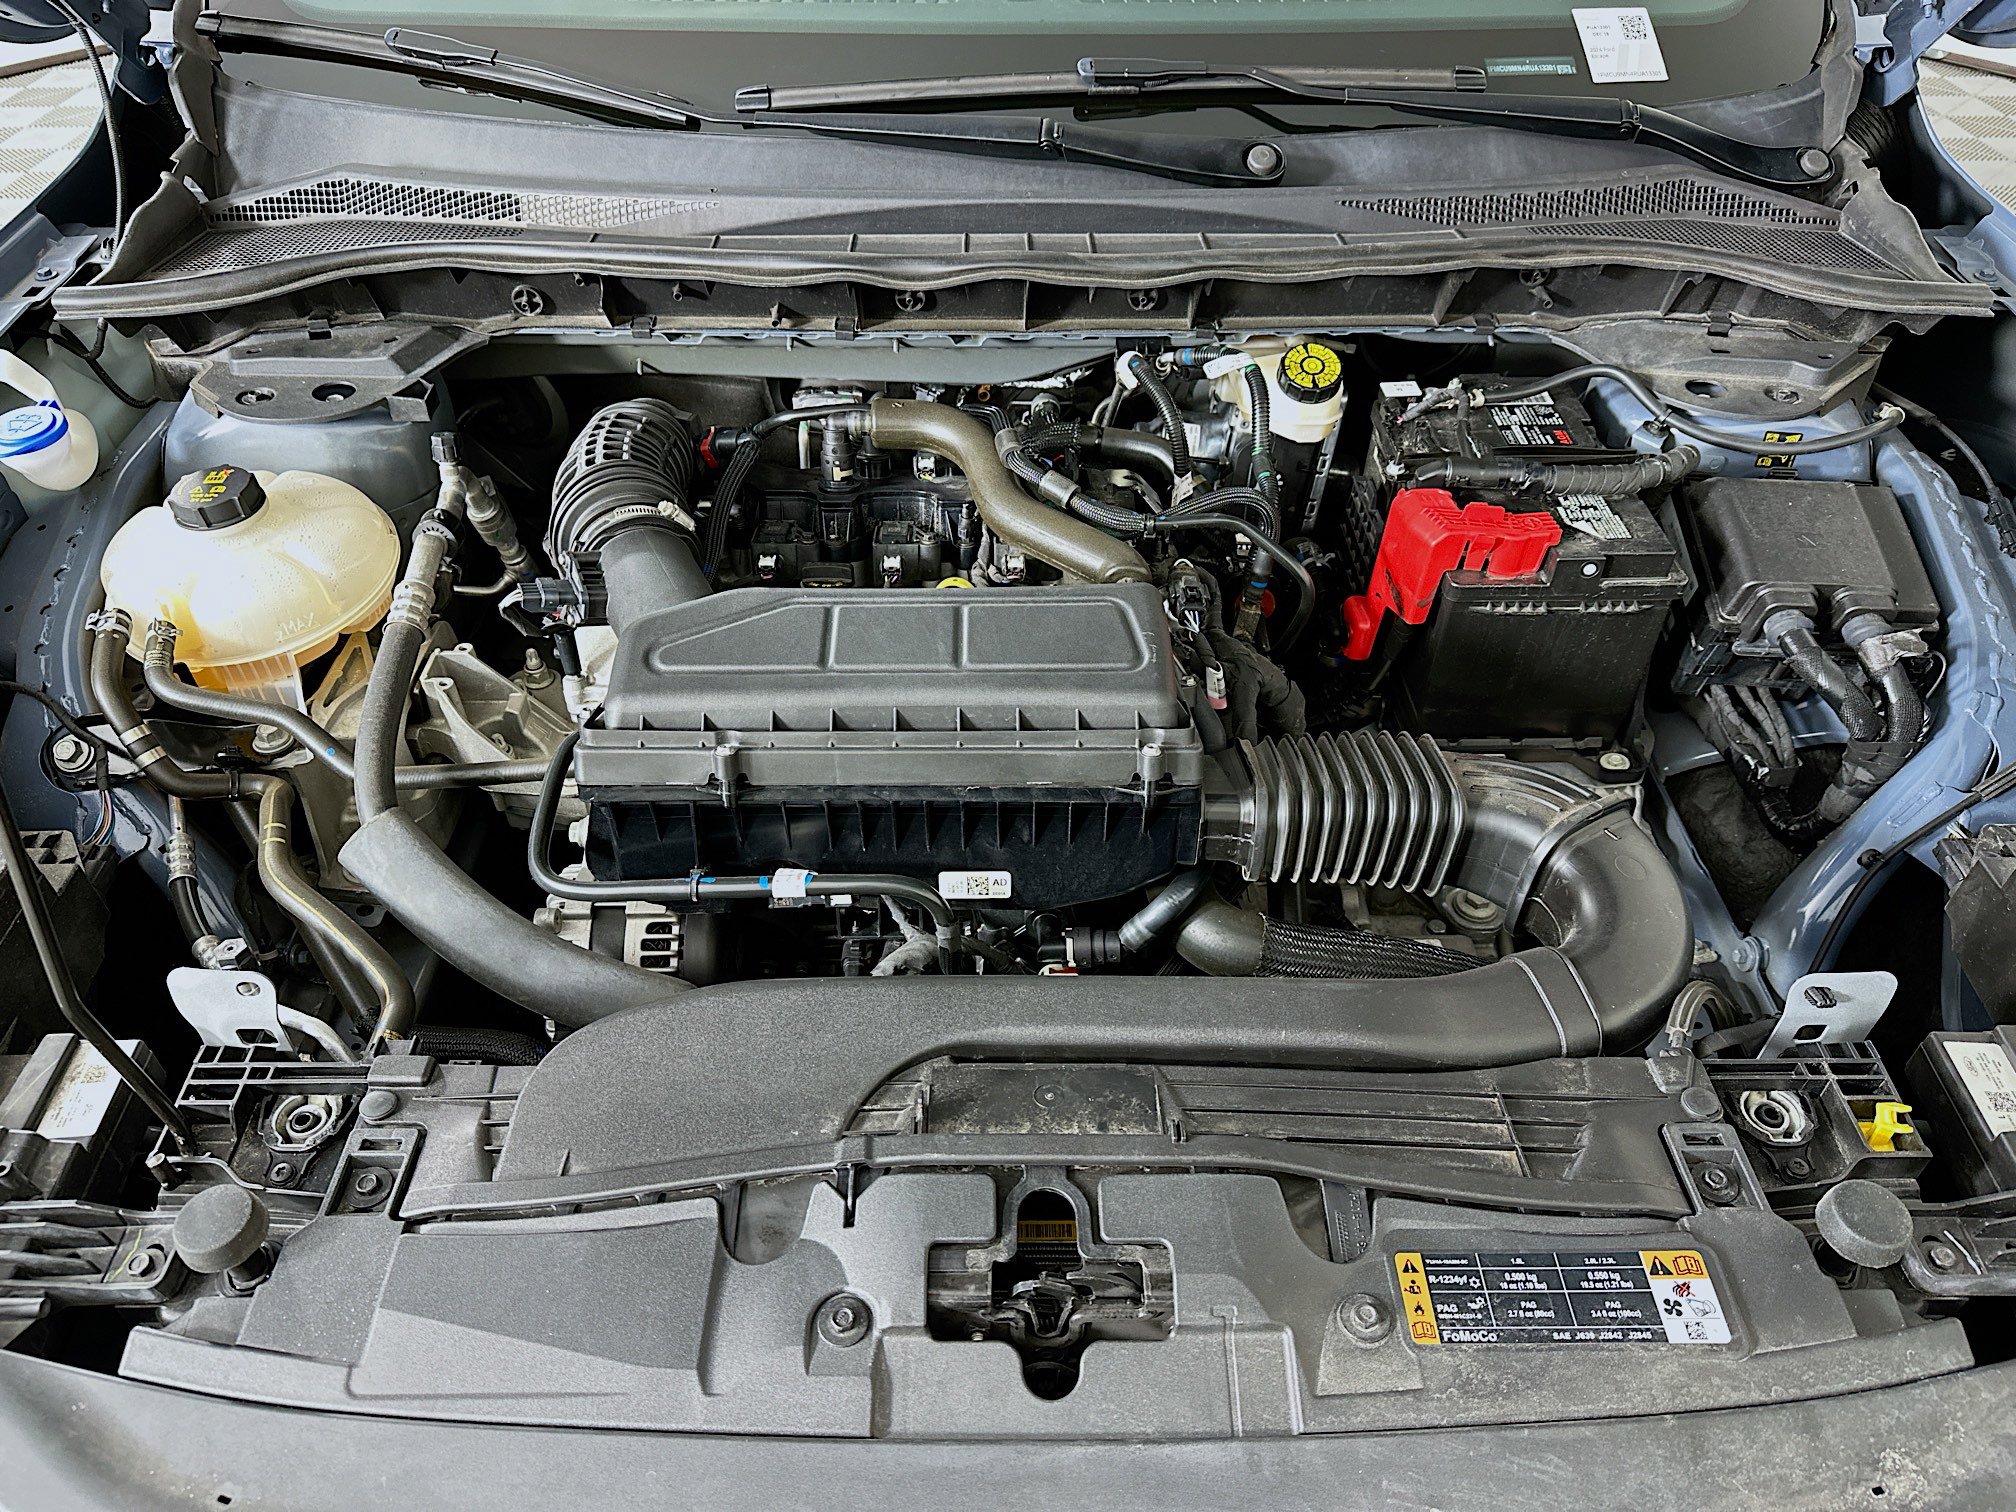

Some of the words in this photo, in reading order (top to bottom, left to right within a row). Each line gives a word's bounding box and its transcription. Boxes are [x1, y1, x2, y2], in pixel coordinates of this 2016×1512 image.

[992, 878, 1008, 886] AD
[1428, 1275, 1467, 1286] R-1234yf
[1504, 1272, 1526, 1281] 0.500
[1526, 1272, 1538, 1283] kg
[1587, 1271, 1609, 1280] 0.550
[1609, 1271, 1621, 1281] kg
[1436, 1304, 1459, 1313] PAG
[1520, 1300, 1537, 1309] PAG
[1604, 1300, 1622, 1309] PAG
[1552, 1331, 1572, 1340] SAE
